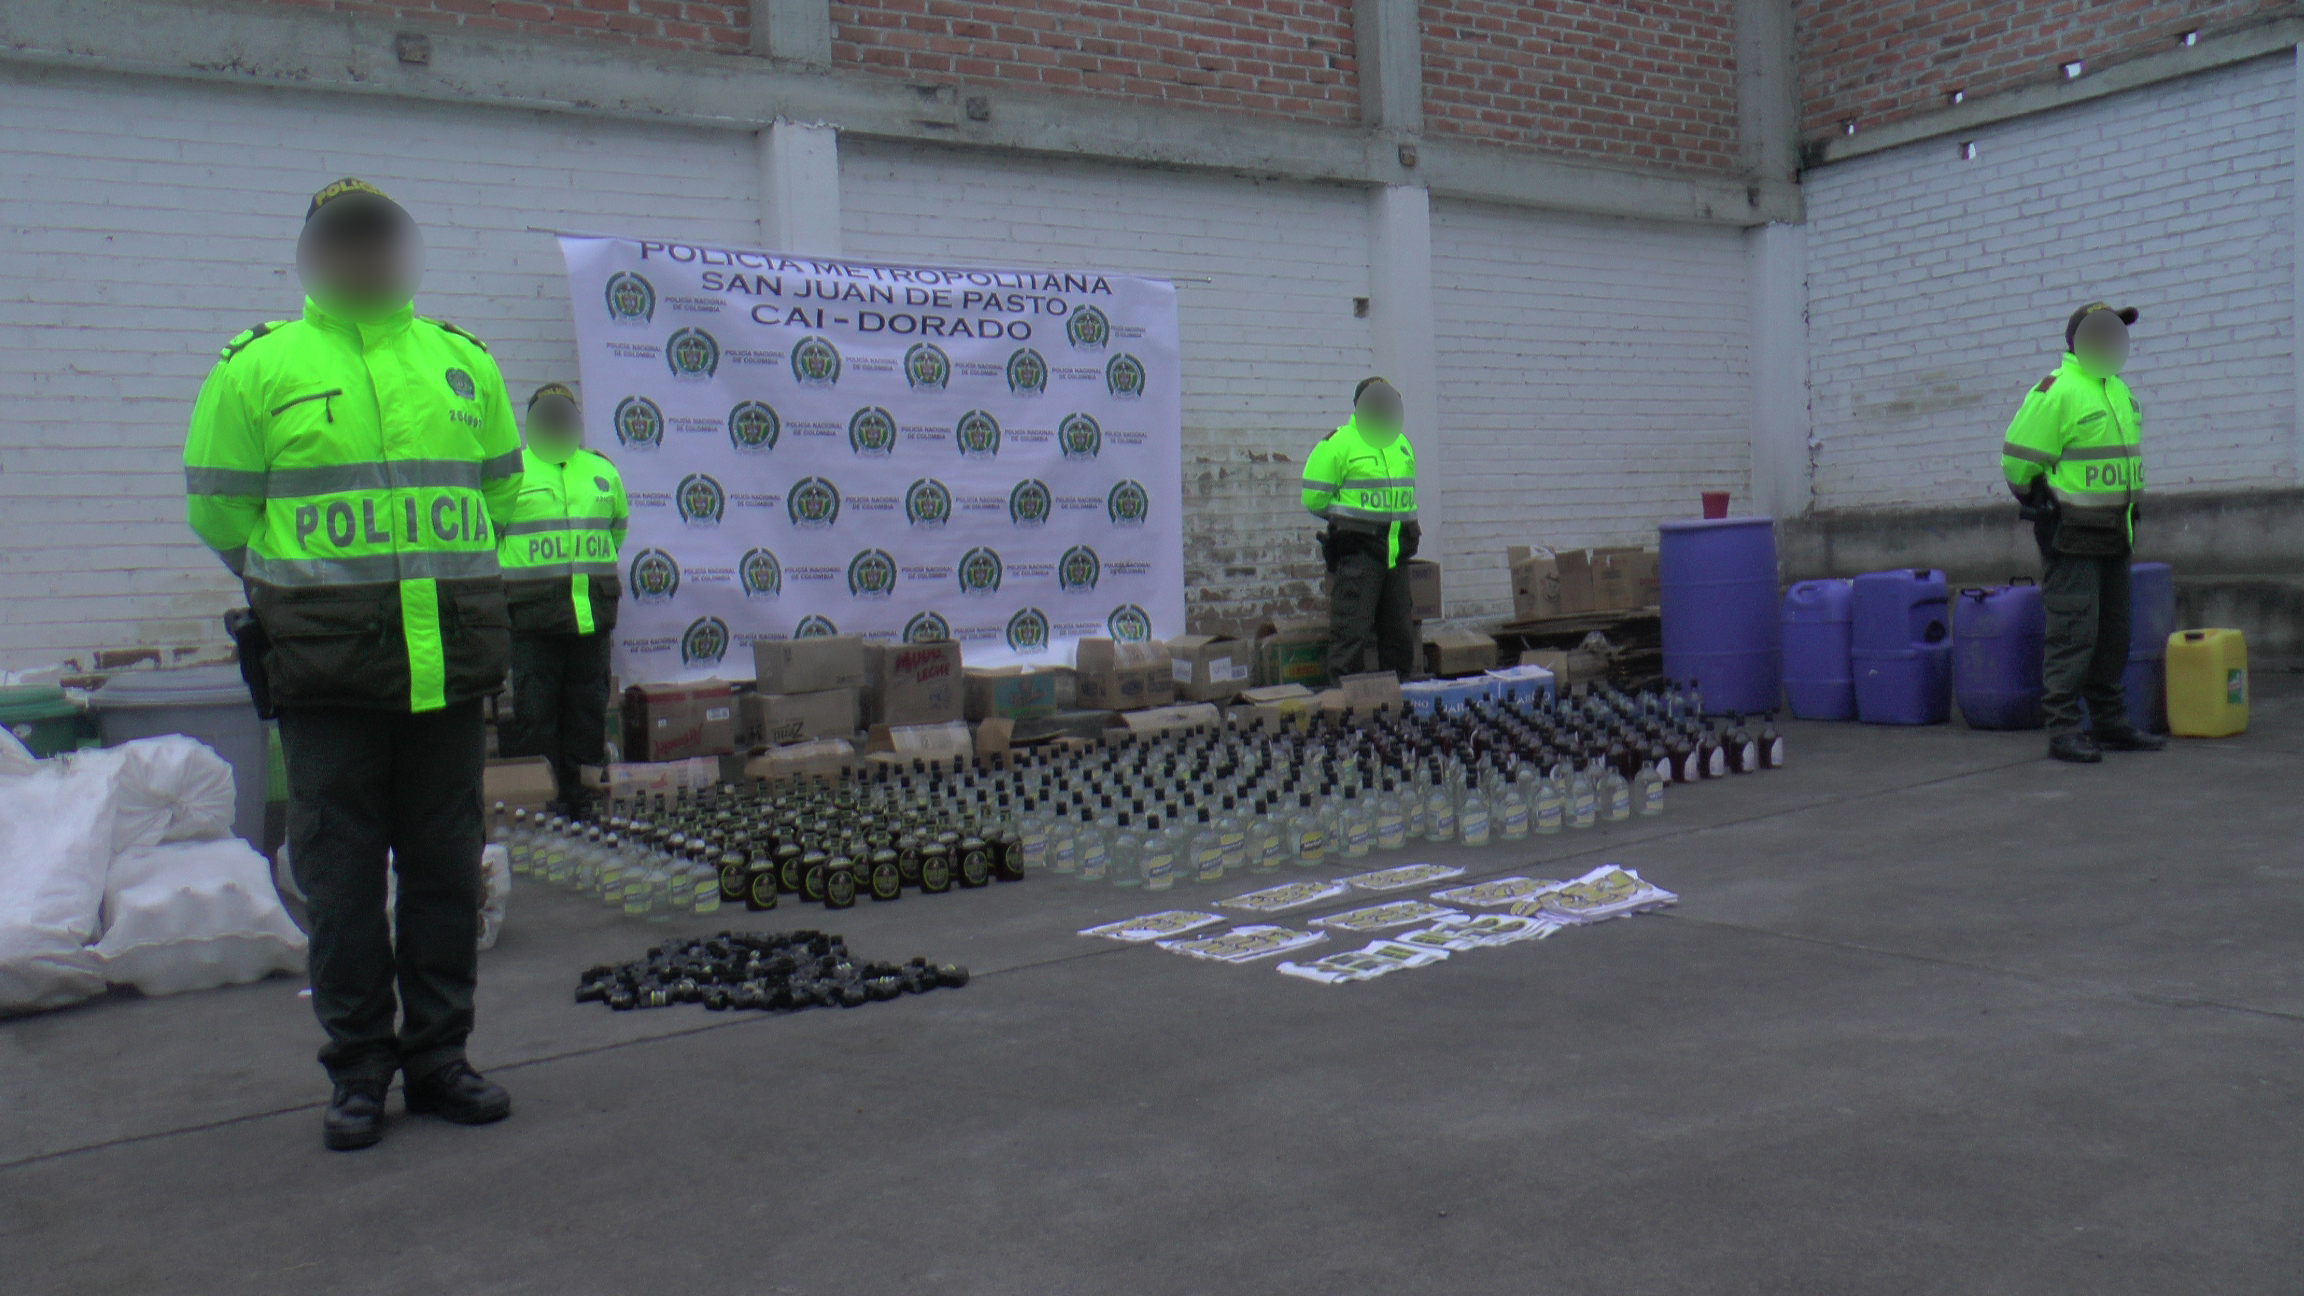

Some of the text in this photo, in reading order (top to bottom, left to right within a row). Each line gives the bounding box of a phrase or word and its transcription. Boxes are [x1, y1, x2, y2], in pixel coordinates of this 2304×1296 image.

[702, 271, 1068, 317] SAN JUAN DE PASTO
[294, 495, 490, 551] POLICIA
[529, 535, 611, 562] POLICIA
